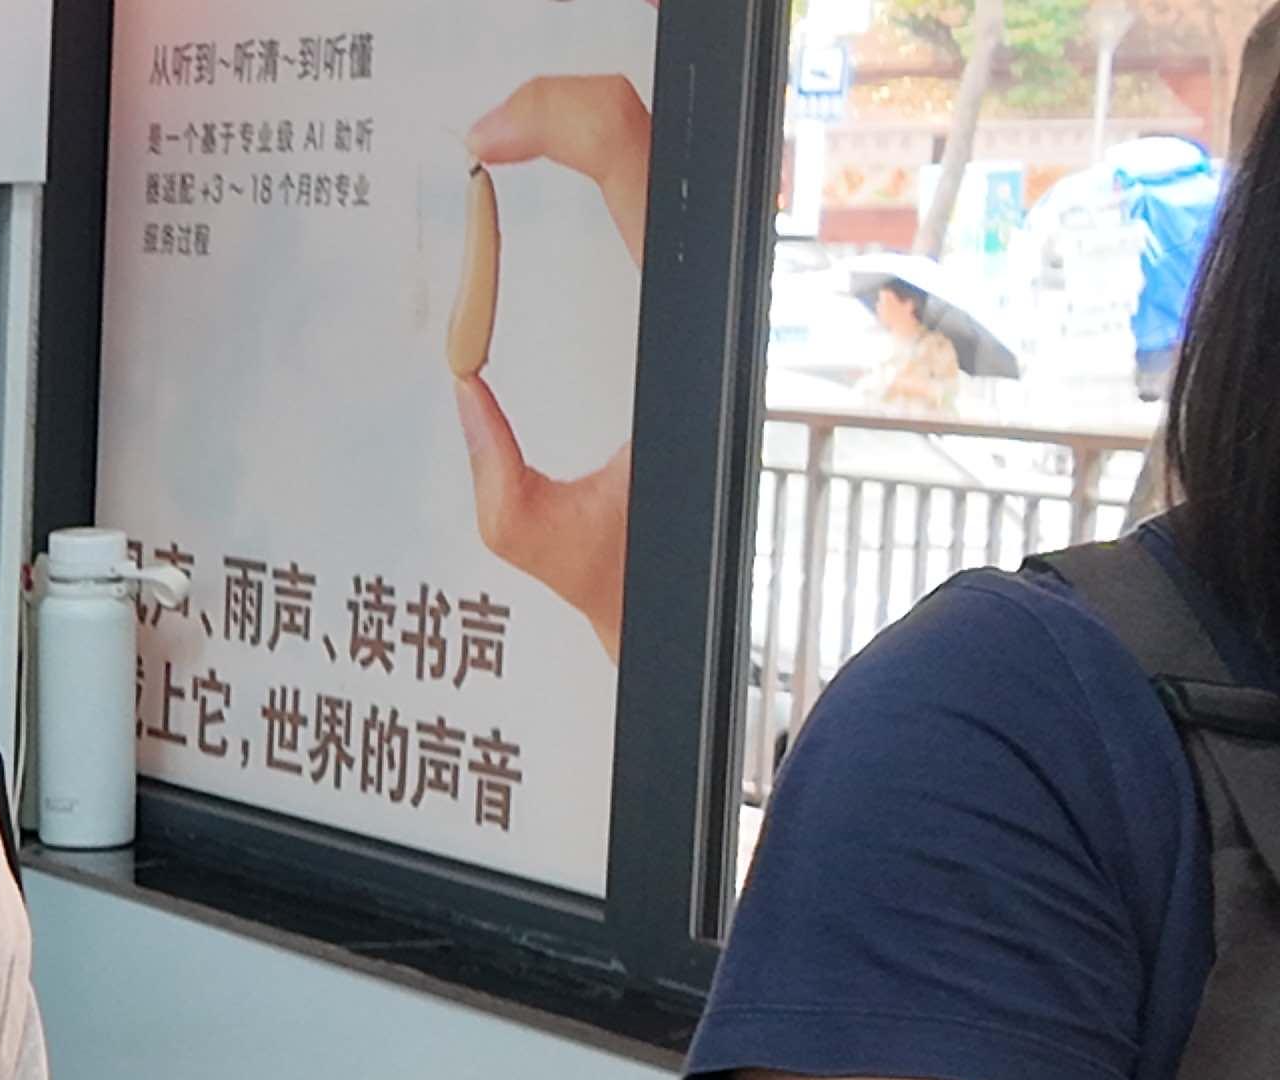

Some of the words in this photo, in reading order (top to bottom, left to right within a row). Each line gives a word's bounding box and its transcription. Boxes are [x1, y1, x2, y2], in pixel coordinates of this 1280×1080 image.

[303, 120, 326, 152] AI
[335, 116, 374, 153] 助听
[142, 221, 211, 256] 服务过程
